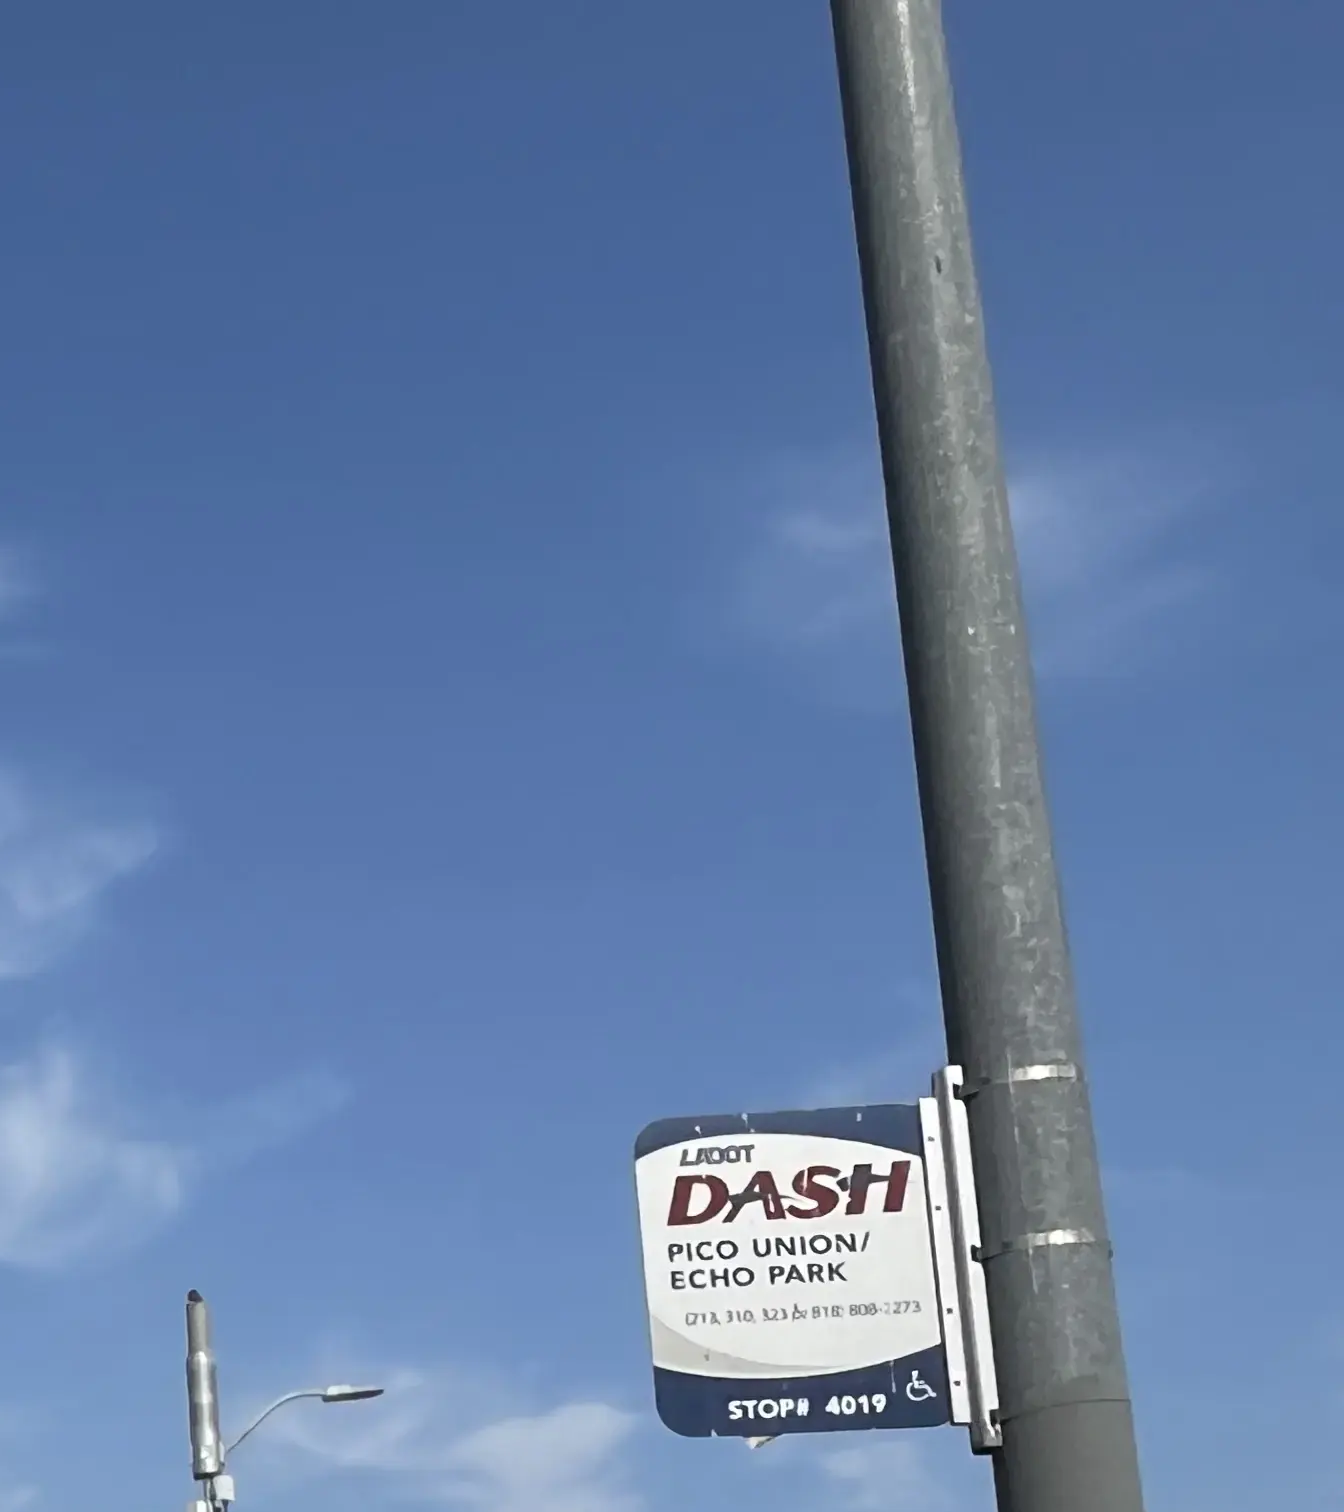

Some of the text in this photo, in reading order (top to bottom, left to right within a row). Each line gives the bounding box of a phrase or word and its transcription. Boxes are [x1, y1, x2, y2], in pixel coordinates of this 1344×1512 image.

[680, 1145, 754, 1166] LADOT
[667, 1160, 911, 1226] DASH
[667, 1232, 870, 1262] PICO UNION/
[671, 1262, 847, 1290] ECHO PARK
[825, 1393, 887, 1416] 4019
